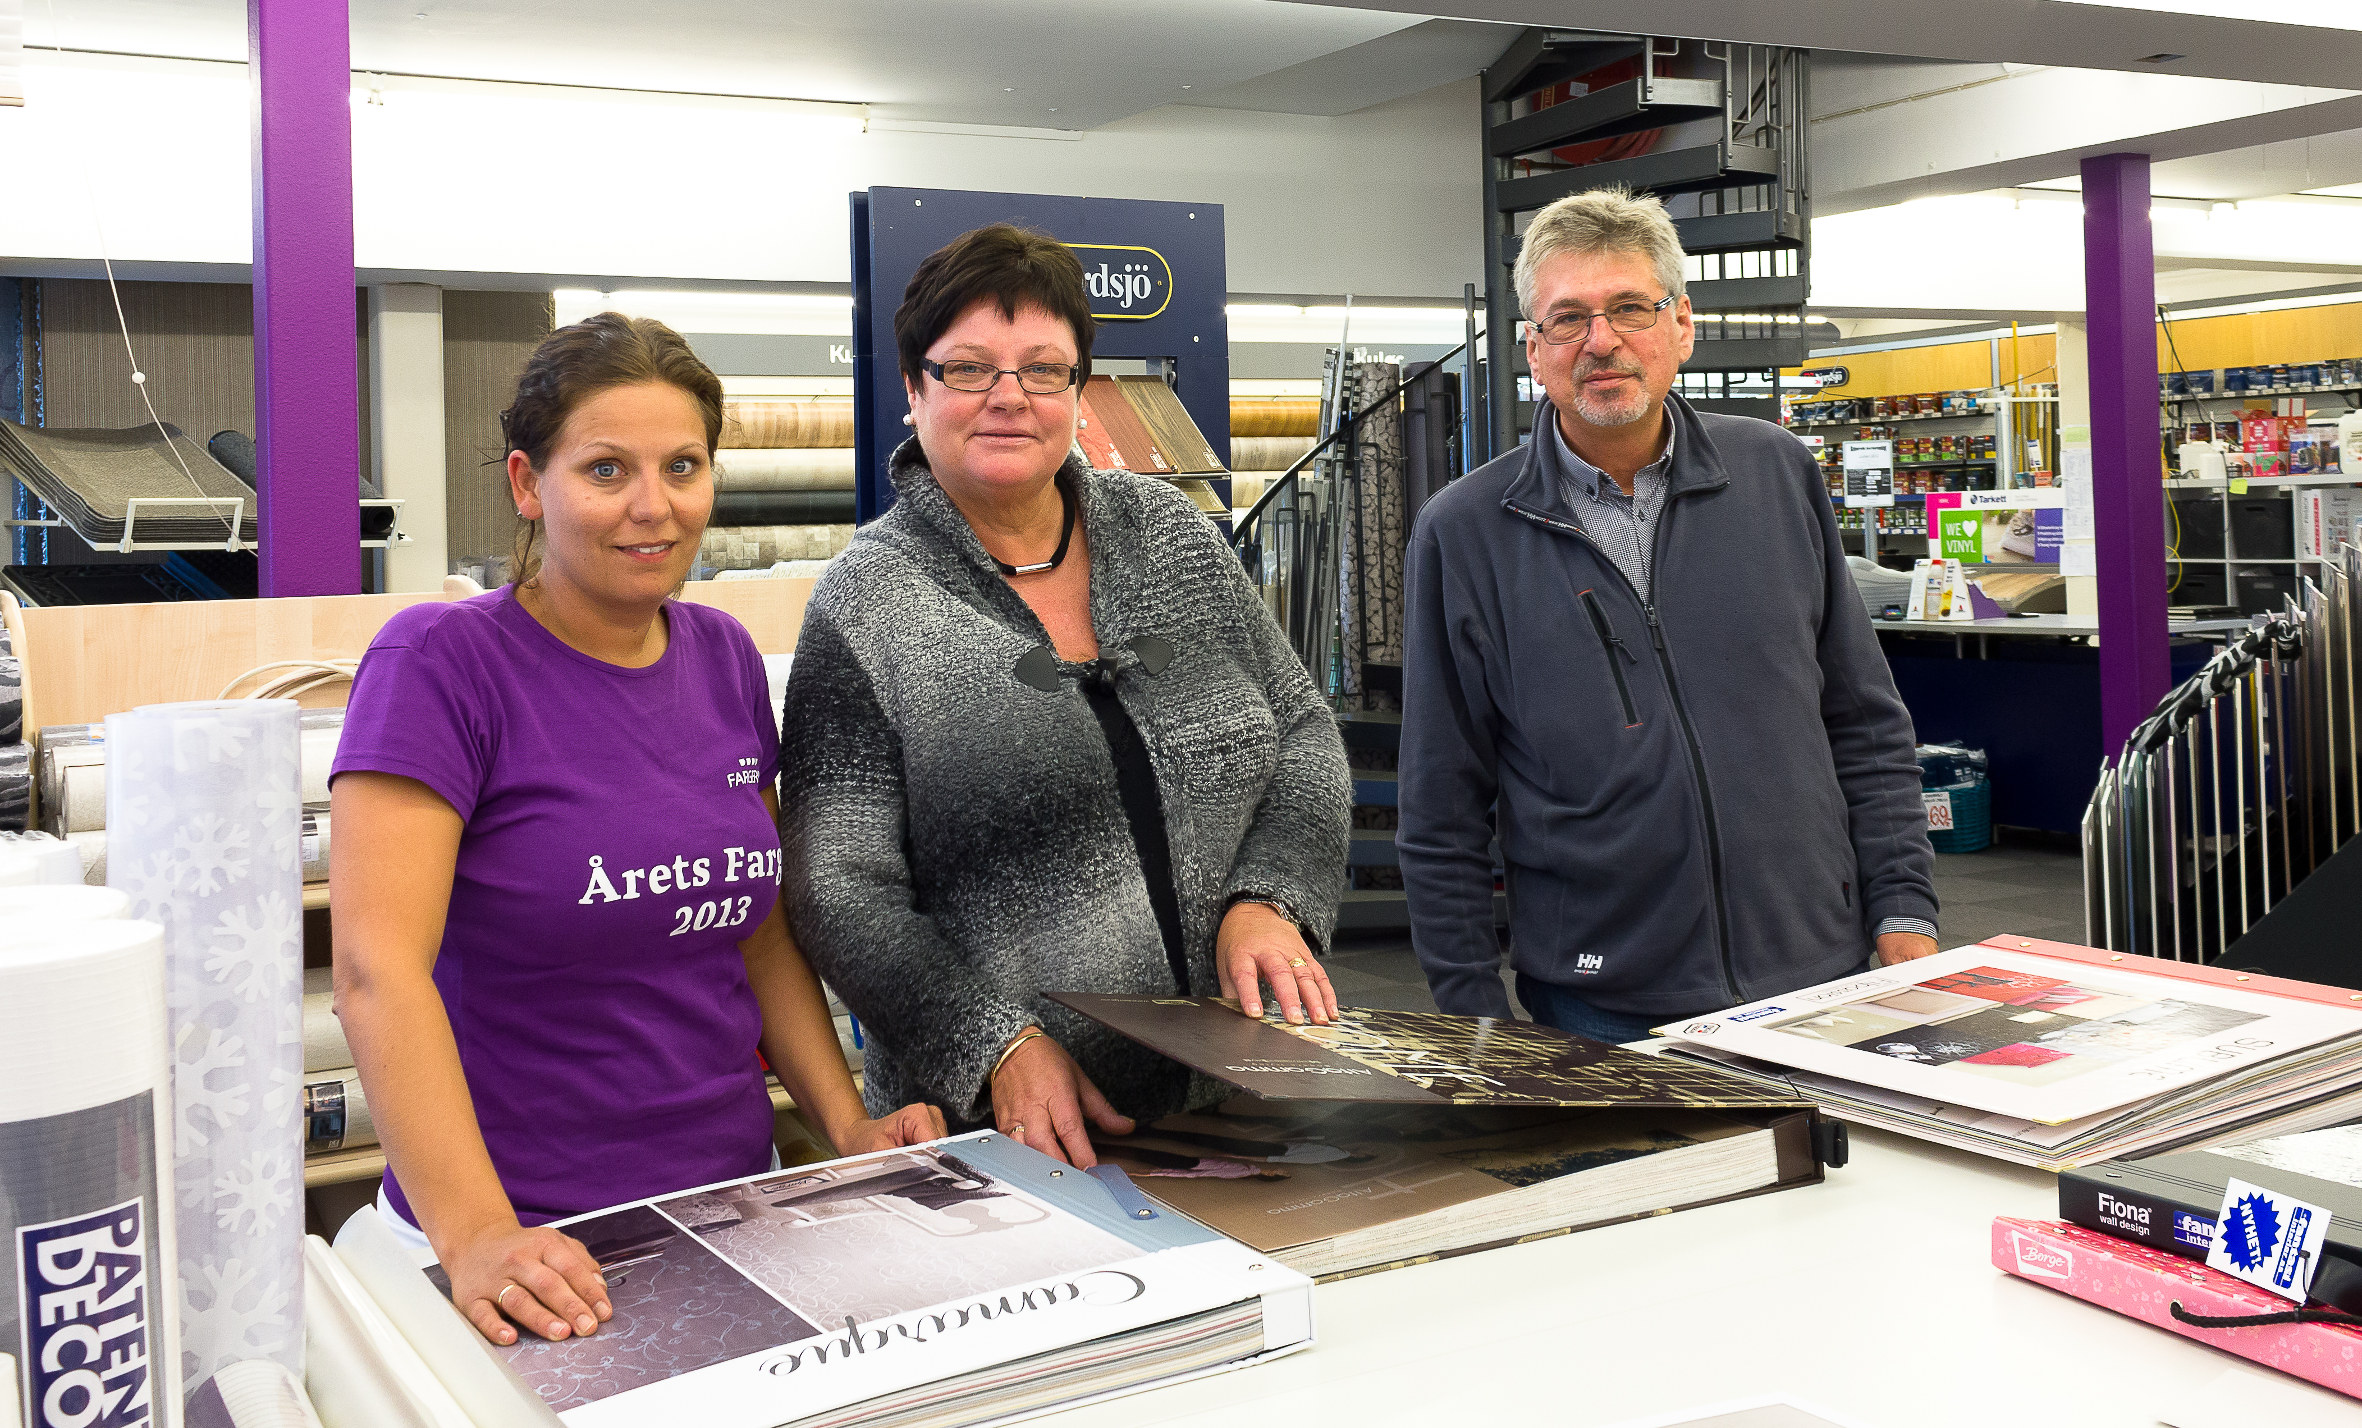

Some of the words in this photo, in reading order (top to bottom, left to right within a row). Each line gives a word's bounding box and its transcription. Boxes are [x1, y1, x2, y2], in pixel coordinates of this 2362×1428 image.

[1979, 495, 2007, 504] Tarkett
[1945, 522, 1962, 537] WE
[1946, 540, 1977, 553] VINYL
[577, 854, 711, 905] Årets
[669, 895, 753, 937] 2013
[1576, 953, 1604, 970] HH
[2099, 1214, 2118, 1227] wall
[2119, 1218, 2150, 1237] design
[2239, 1202, 2262, 1265] NYHET!
[2021, 1246, 2066, 1268] Borge
[96, 1203, 150, 1428] PATEN
